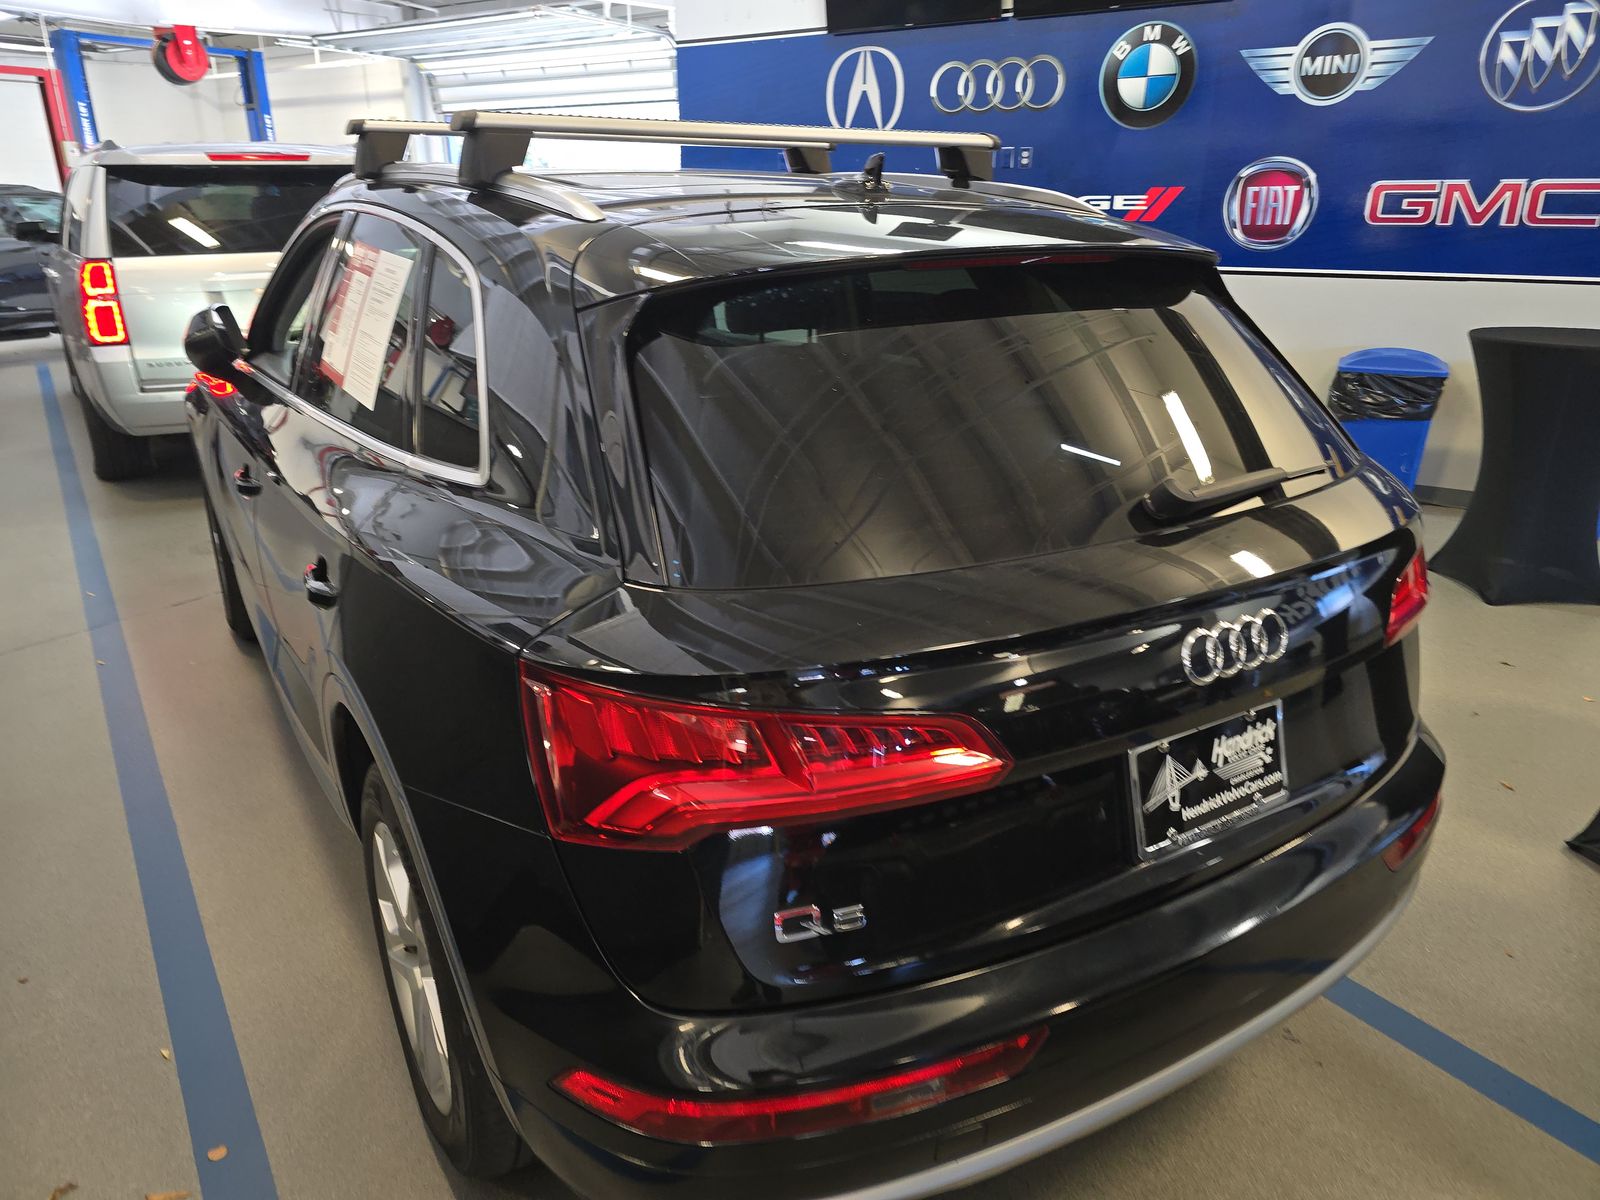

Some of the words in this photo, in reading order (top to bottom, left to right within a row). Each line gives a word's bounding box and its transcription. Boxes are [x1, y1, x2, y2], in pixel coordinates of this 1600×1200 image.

[1114, 24, 1193, 61] BMW
[1300, 53, 1360, 77] MINI
[1244, 185, 1298, 226] FIAT
[1364, 178, 1600, 228] GMC
[773, 903, 867, 944] Q5
